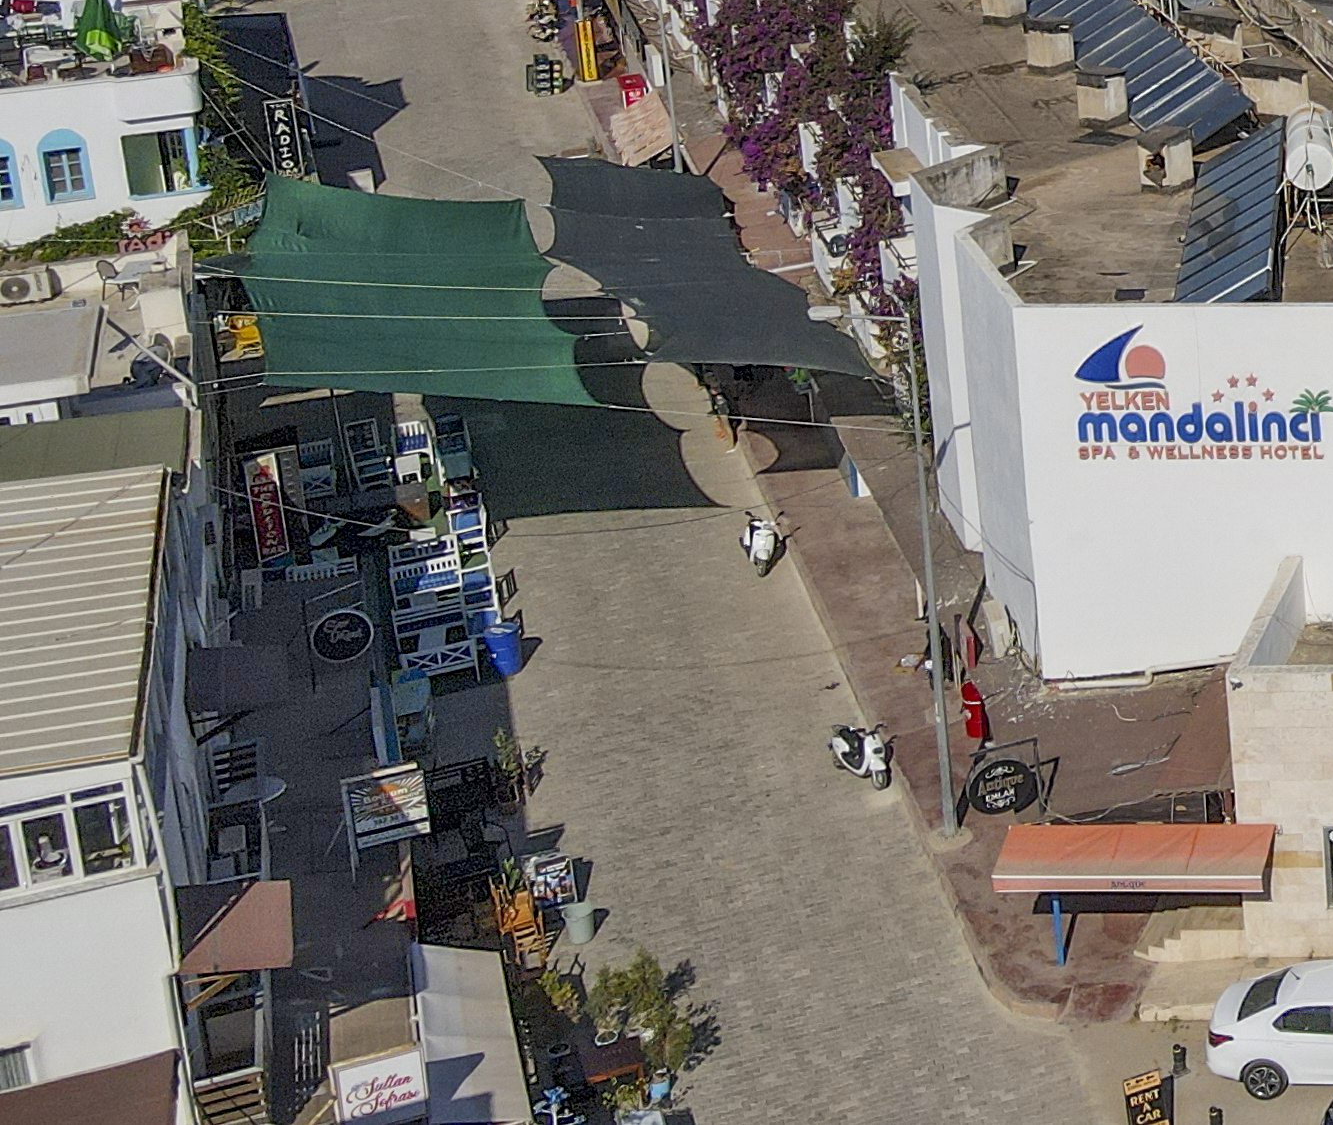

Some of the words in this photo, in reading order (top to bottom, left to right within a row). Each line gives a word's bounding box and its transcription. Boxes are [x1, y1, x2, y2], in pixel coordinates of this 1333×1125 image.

[274, 109, 295, 169] RADIO
[1079, 391, 1170, 411] YELKEN
[1078, 445, 1116, 461] SPA
[1127, 445, 1140, 460] &
[1146, 445, 1253, 461] WELLNESS
[1260, 445, 1325, 461] HOTEL
[978, 774, 1024, 797] Antique
[345, 1073, 413, 1104] Sultan
[1130, 1088, 1160, 1107] RENT
[1136, 1108, 1162, 1124] CAR
[1143, 1102, 1152, 1113] A
